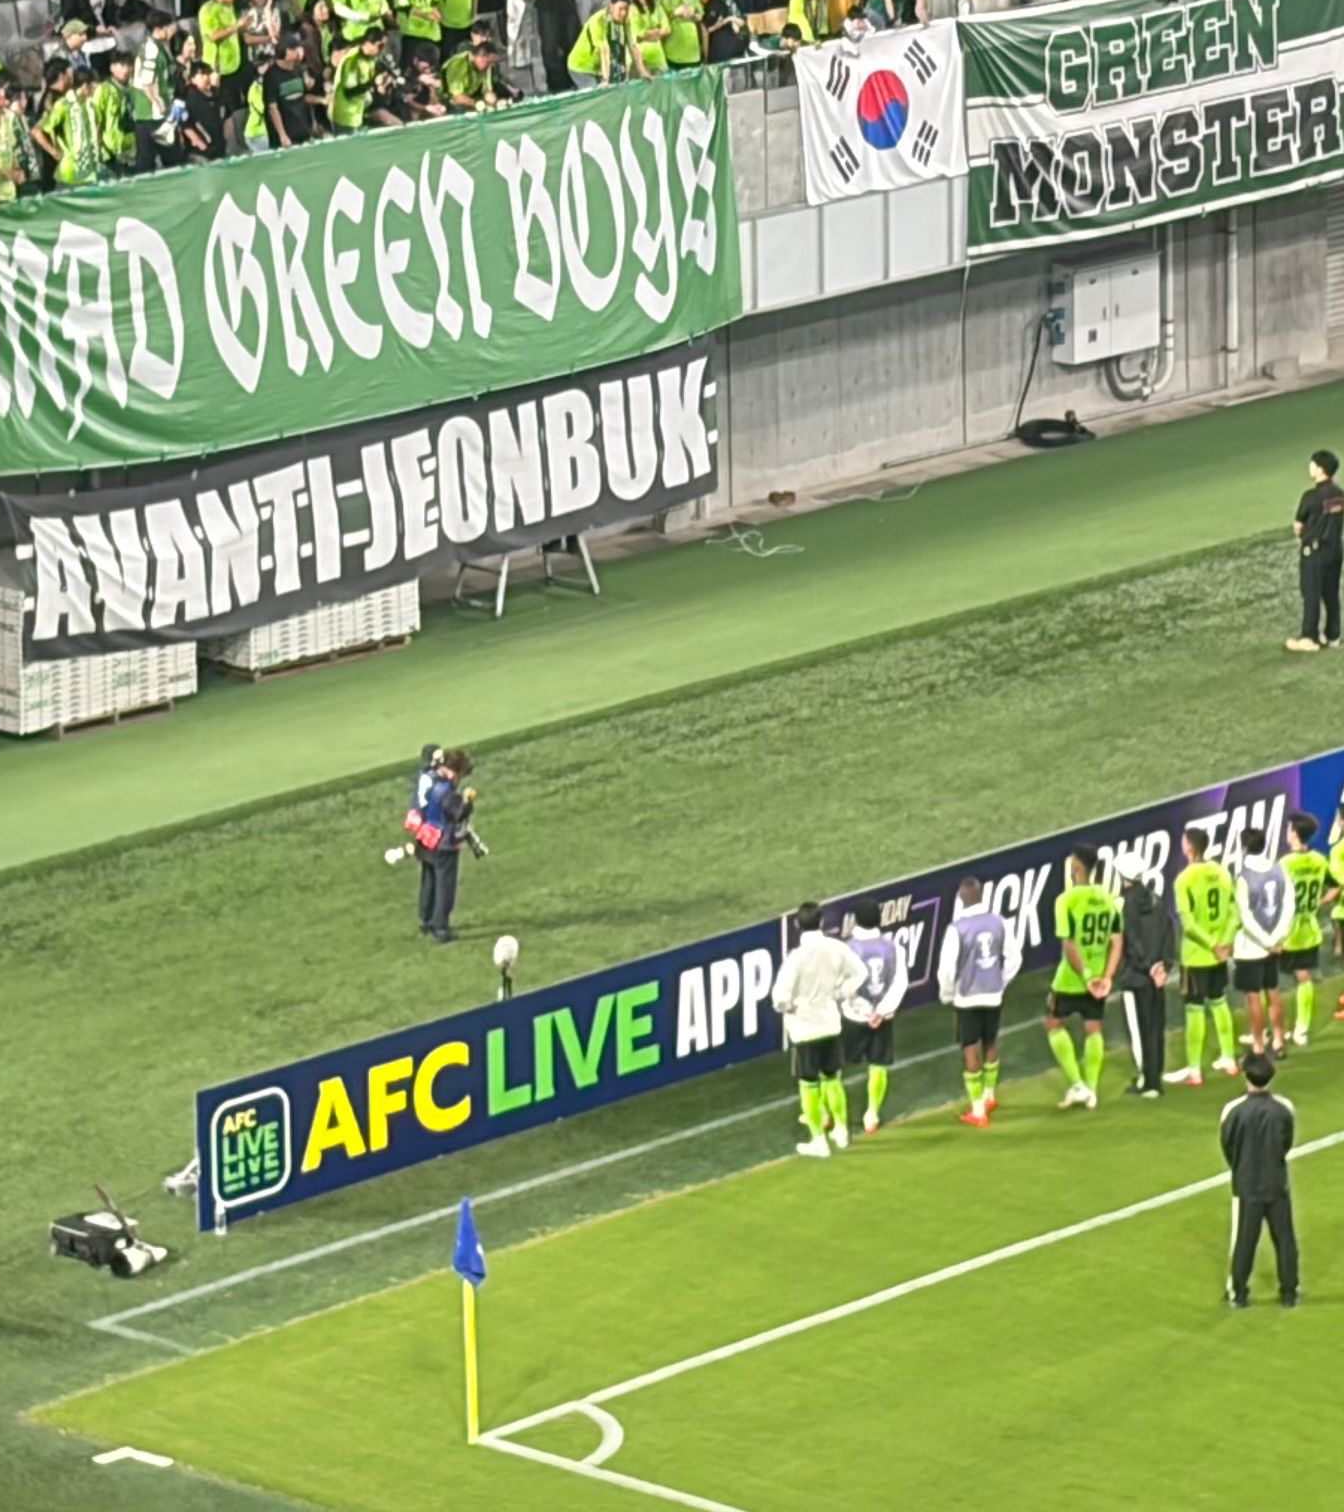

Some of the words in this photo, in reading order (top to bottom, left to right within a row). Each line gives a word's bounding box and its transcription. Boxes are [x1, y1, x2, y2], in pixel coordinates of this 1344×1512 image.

[988, 75, 1344, 229] MONSTER
[203, 149, 493, 393] GREEN
[494, 101, 719, 324] BOYS
[1206, 886, 1220, 922] 9
[1294, 879, 1319, 914] 28
[1082, 913, 1111, 947] 99
[301, 1040, 471, 1174] AFC
[486, 980, 661, 1117] LIVE
[676, 949, 775, 1059] APP
[222, 1108, 257, 1136] AFC
[222, 1121, 279, 1165] LIVE
